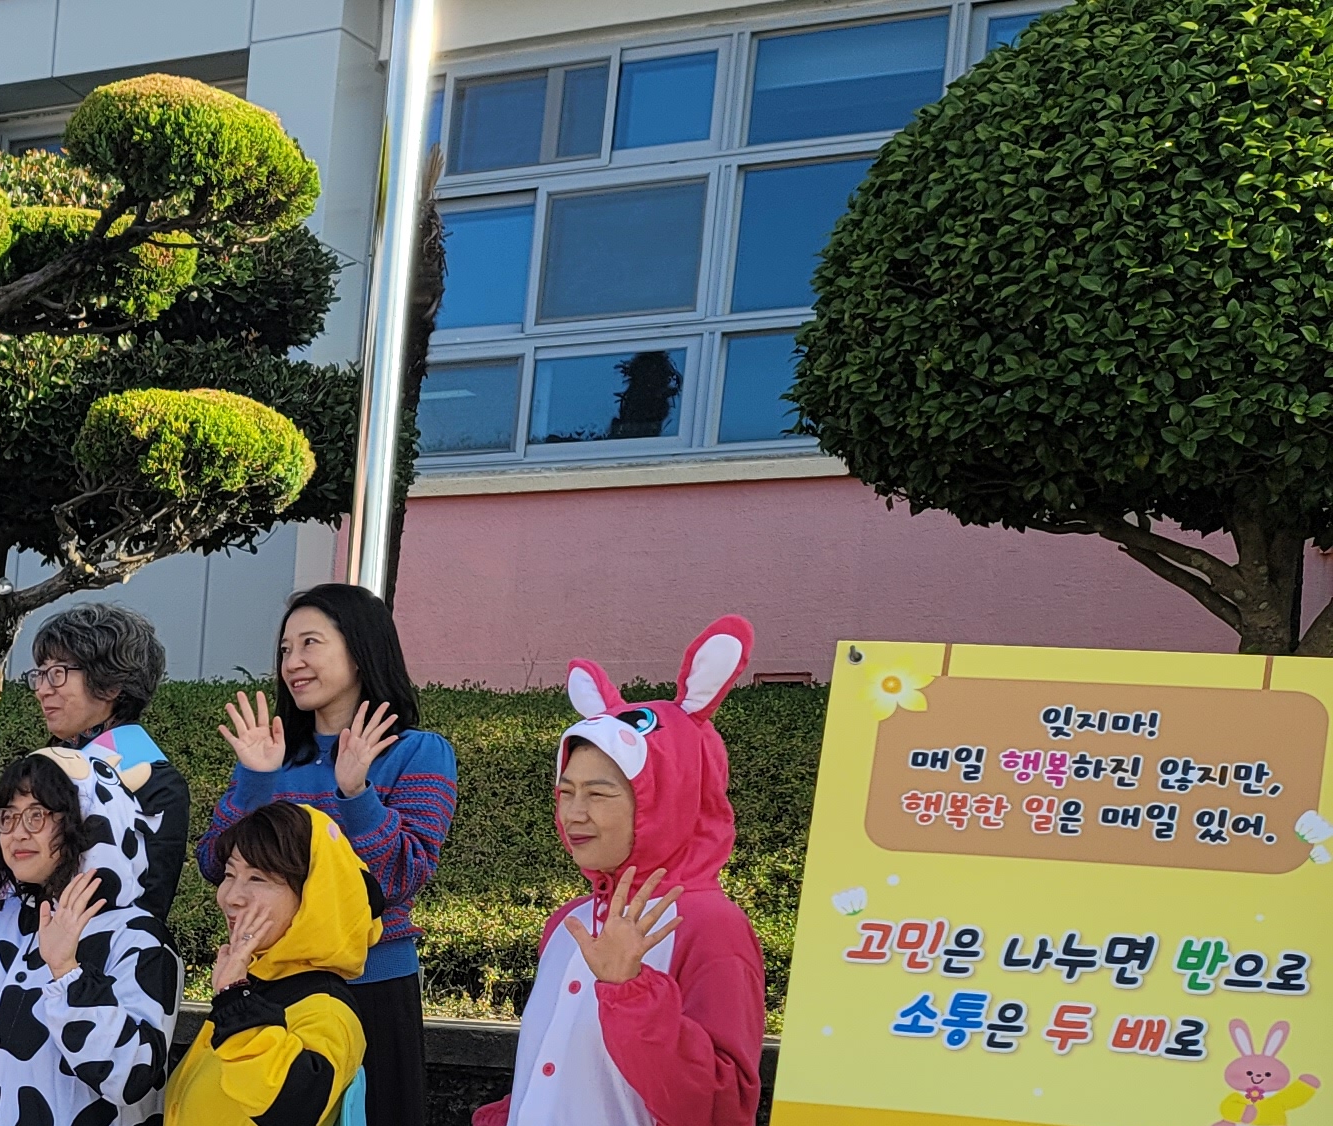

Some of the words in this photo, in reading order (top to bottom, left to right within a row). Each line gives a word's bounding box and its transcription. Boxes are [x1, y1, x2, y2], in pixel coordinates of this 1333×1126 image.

[1041, 705, 1161, 739] 잊지마!
[910, 746, 986, 783] 매일
[1000, 750, 1144, 790] 행복하진
[1158, 757, 1284, 798] 않지만,
[902, 791, 1010, 829] 행복한
[1023, 796, 1085, 836] 일은
[1099, 803, 1178, 841] 매일
[1194, 807, 1278, 844] 있어.
[845, 921, 984, 974] 고민은
[1001, 934, 1157, 989] 나누면
[1175, 937, 1310, 995] 반으로
[891, 992, 1027, 1051] 소통은
[1045, 1003, 1095, 1054] 두
[1109, 1017, 1207, 1061] 배로
